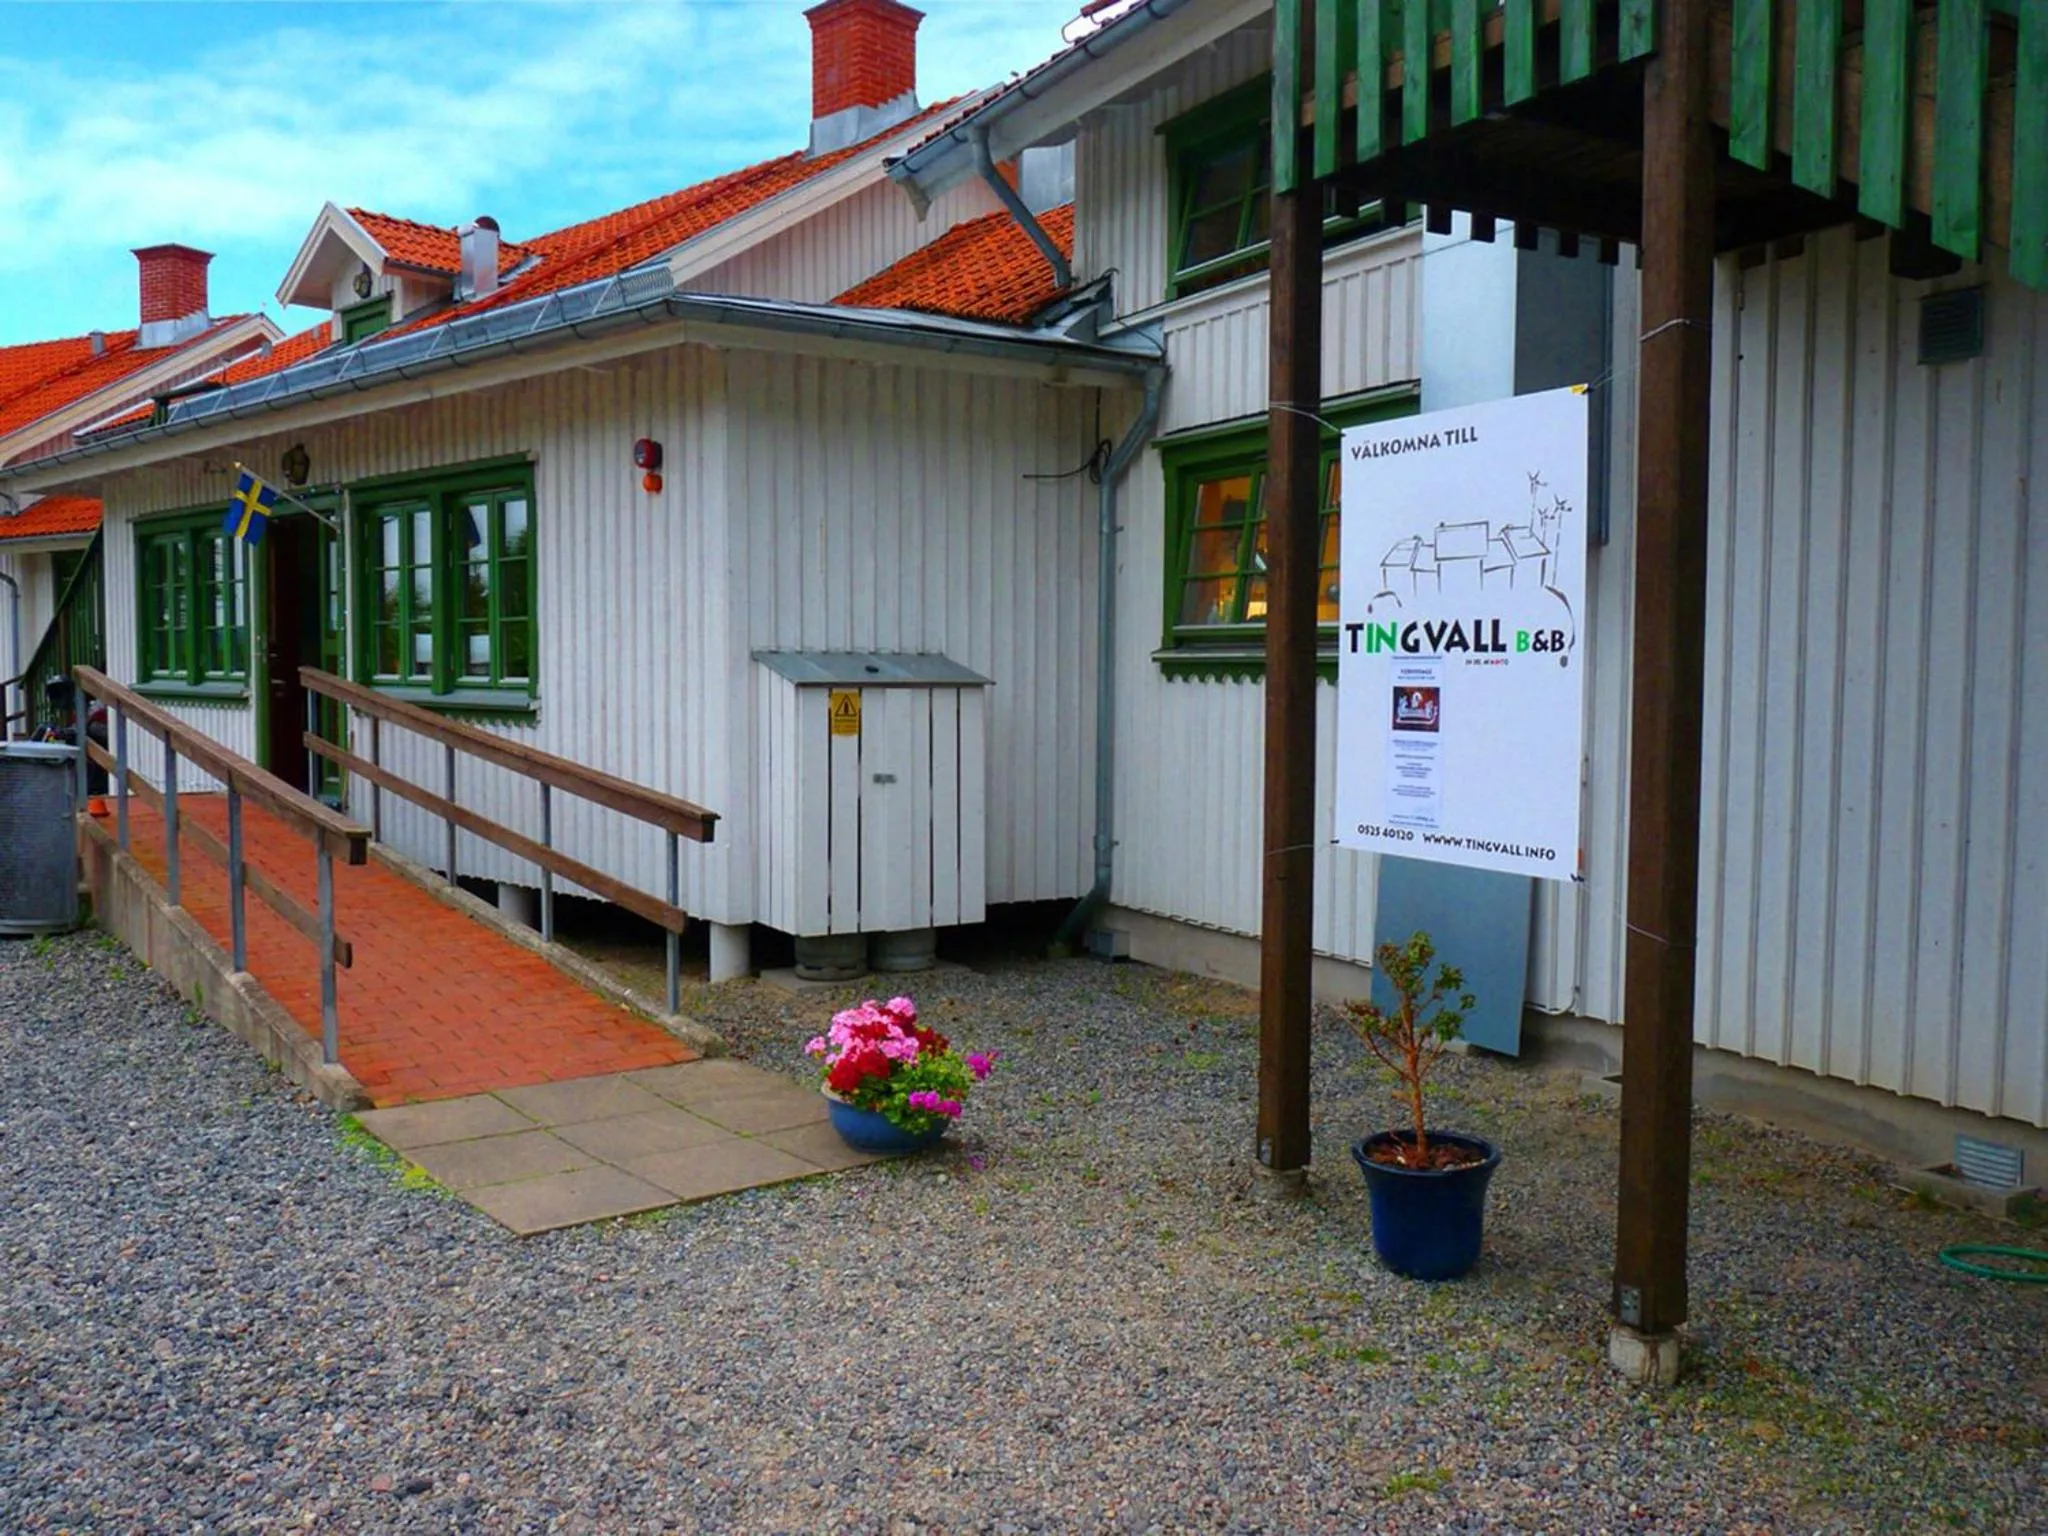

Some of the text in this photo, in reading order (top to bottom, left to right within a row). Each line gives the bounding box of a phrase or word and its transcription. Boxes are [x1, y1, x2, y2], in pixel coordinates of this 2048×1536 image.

[1351, 426, 1478, 460] VÄLKOMNA TILL
[1345, 618, 1565, 654] TINGVALL B&B
